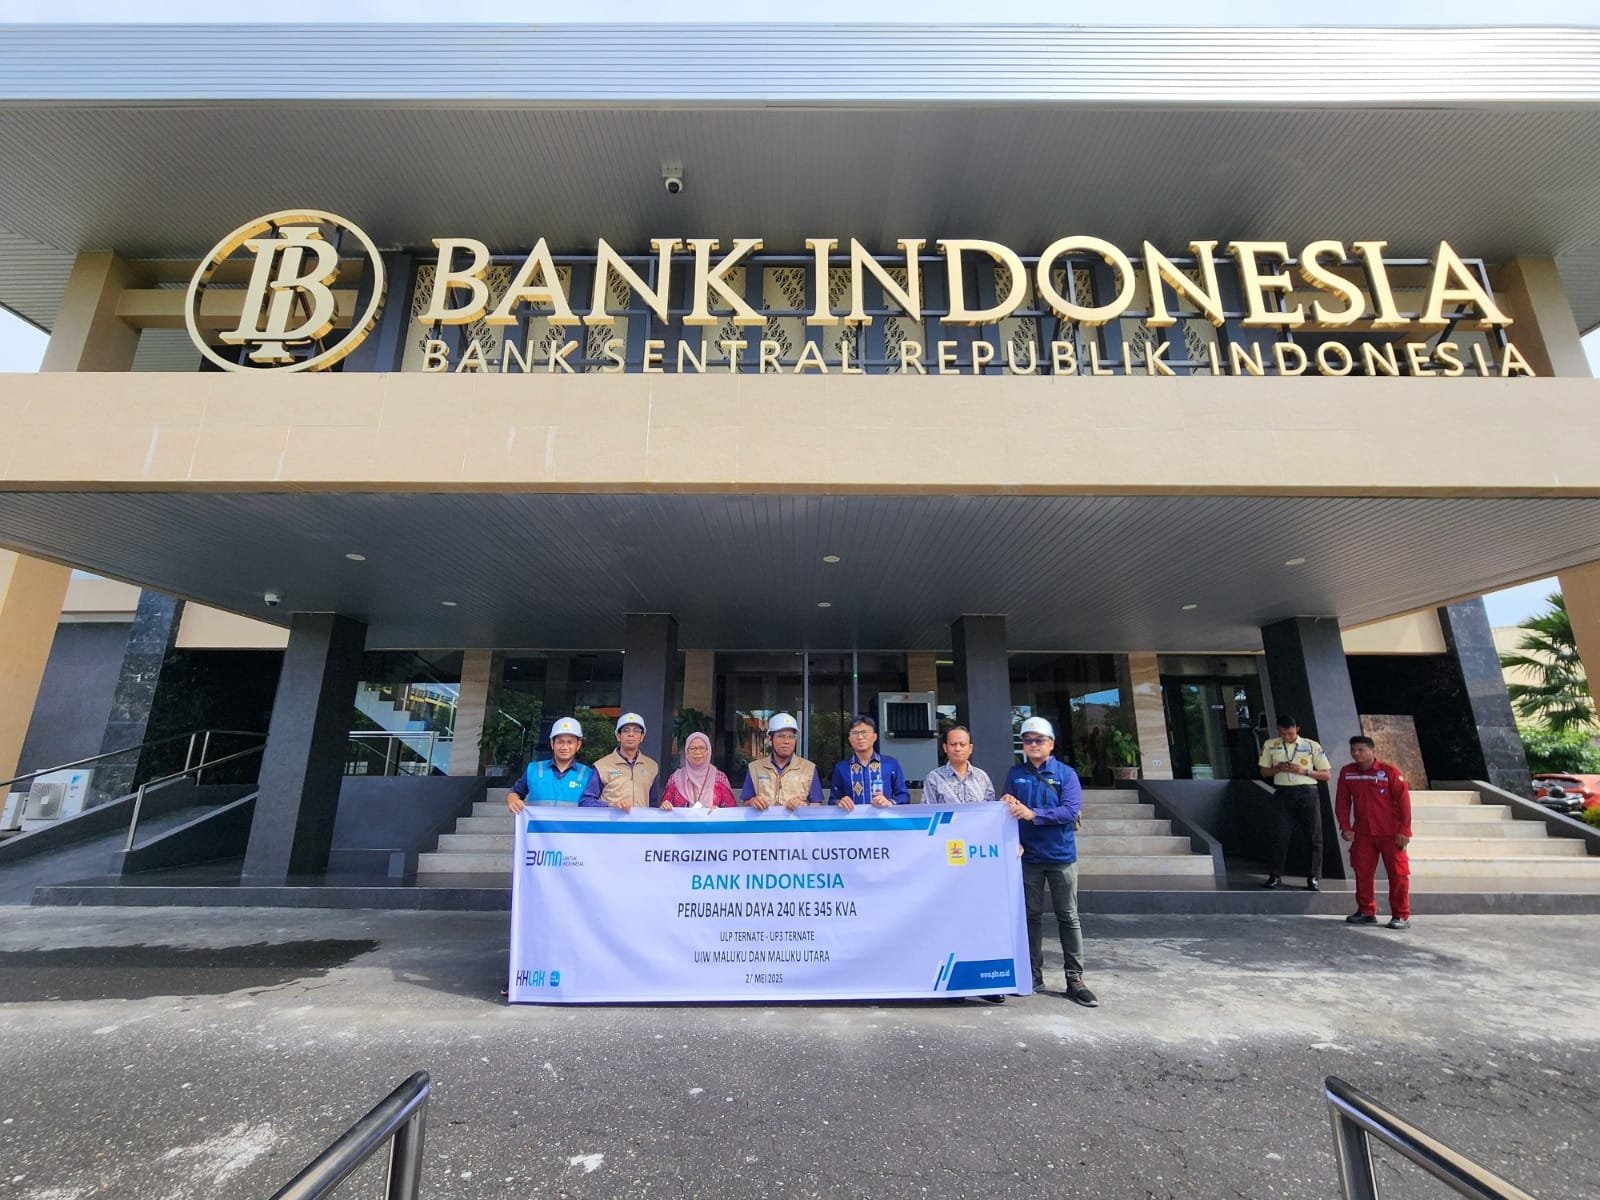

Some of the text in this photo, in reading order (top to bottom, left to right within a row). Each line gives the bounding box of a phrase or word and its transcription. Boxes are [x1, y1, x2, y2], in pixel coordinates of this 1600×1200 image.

[418, 235, 1514, 328] BANK INDONESIA
[422, 339, 1537, 378] BANK SENTRAL REPUBLIK INDONESIA
[644, 847, 890, 862] ENERGIZING POTENTIAL CUSTOMER
[968, 844, 999, 859] PLN
[691, 873, 845, 890] BANK INDONESIA
[677, 901, 857, 918] PERUBAHAN DAYA 240 KE 345 KVA
[720, 931, 733, 942] ULP
[734, 931, 765, 941] TERNATE
[769, 931, 784, 942] UP3
[784, 931, 815, 941] TERNATE
[694, 950, 830, 963] UIW MALUKU DAN MALUKU UTARA
[754, 973, 767, 984] MEI
[768, 973, 784, 984] 2025
